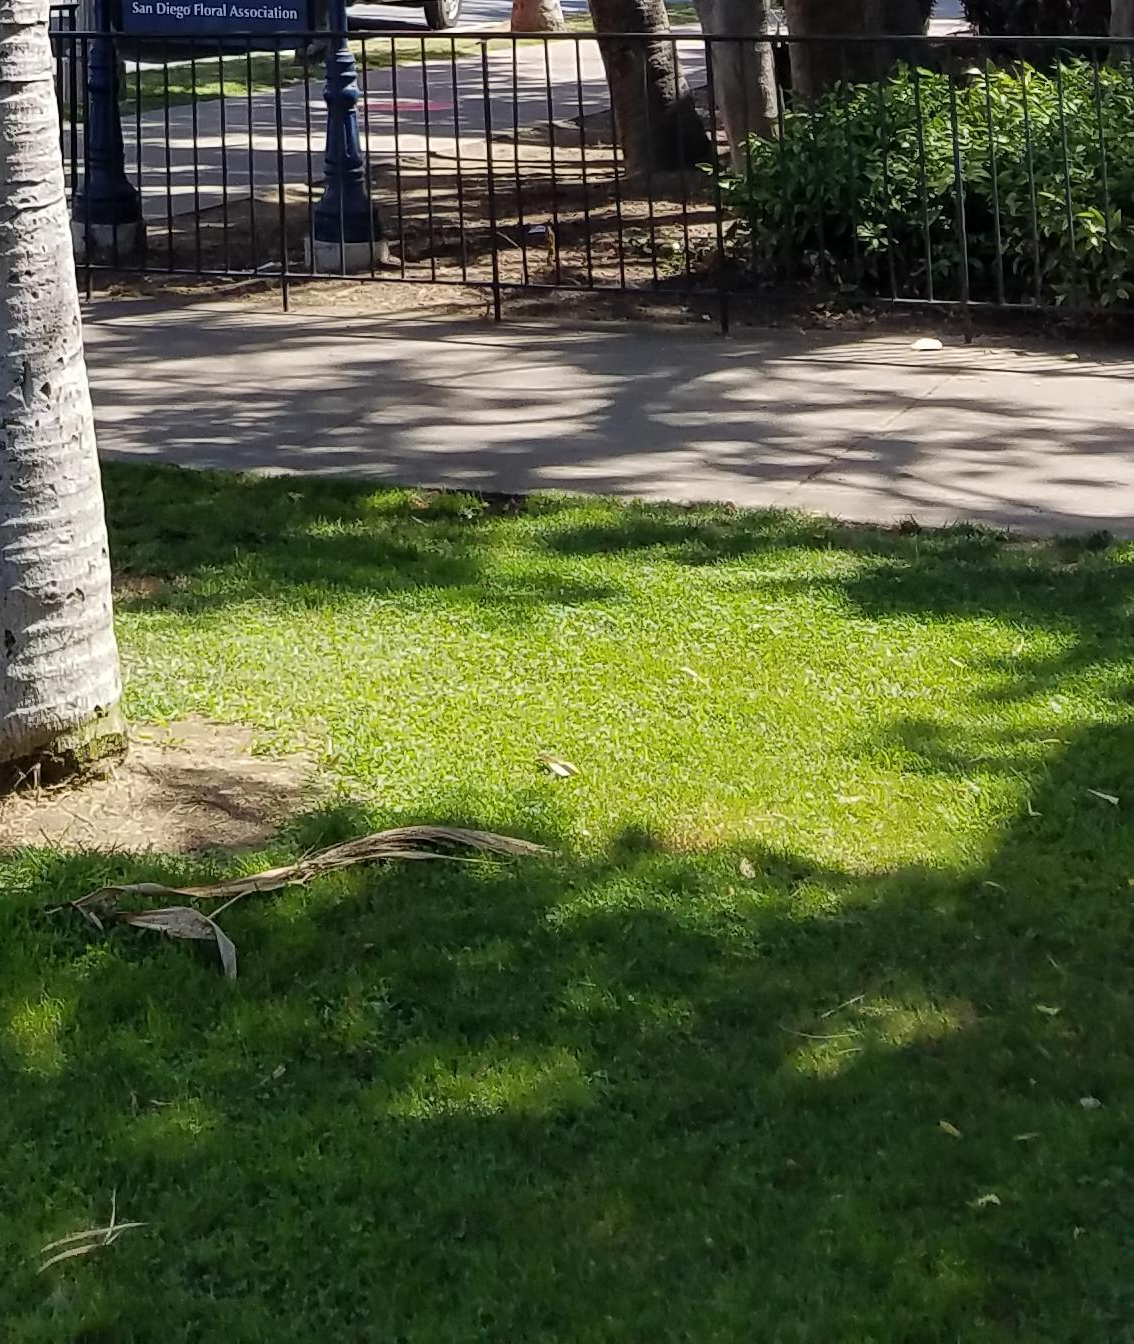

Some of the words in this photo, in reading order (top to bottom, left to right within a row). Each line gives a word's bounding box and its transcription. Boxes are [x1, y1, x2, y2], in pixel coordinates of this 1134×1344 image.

[132, 2, 153, 13] San
[156, 2, 190, 19] Diego
[194, 3, 226, 16] Floral
[230, 5, 297, 19] Association
